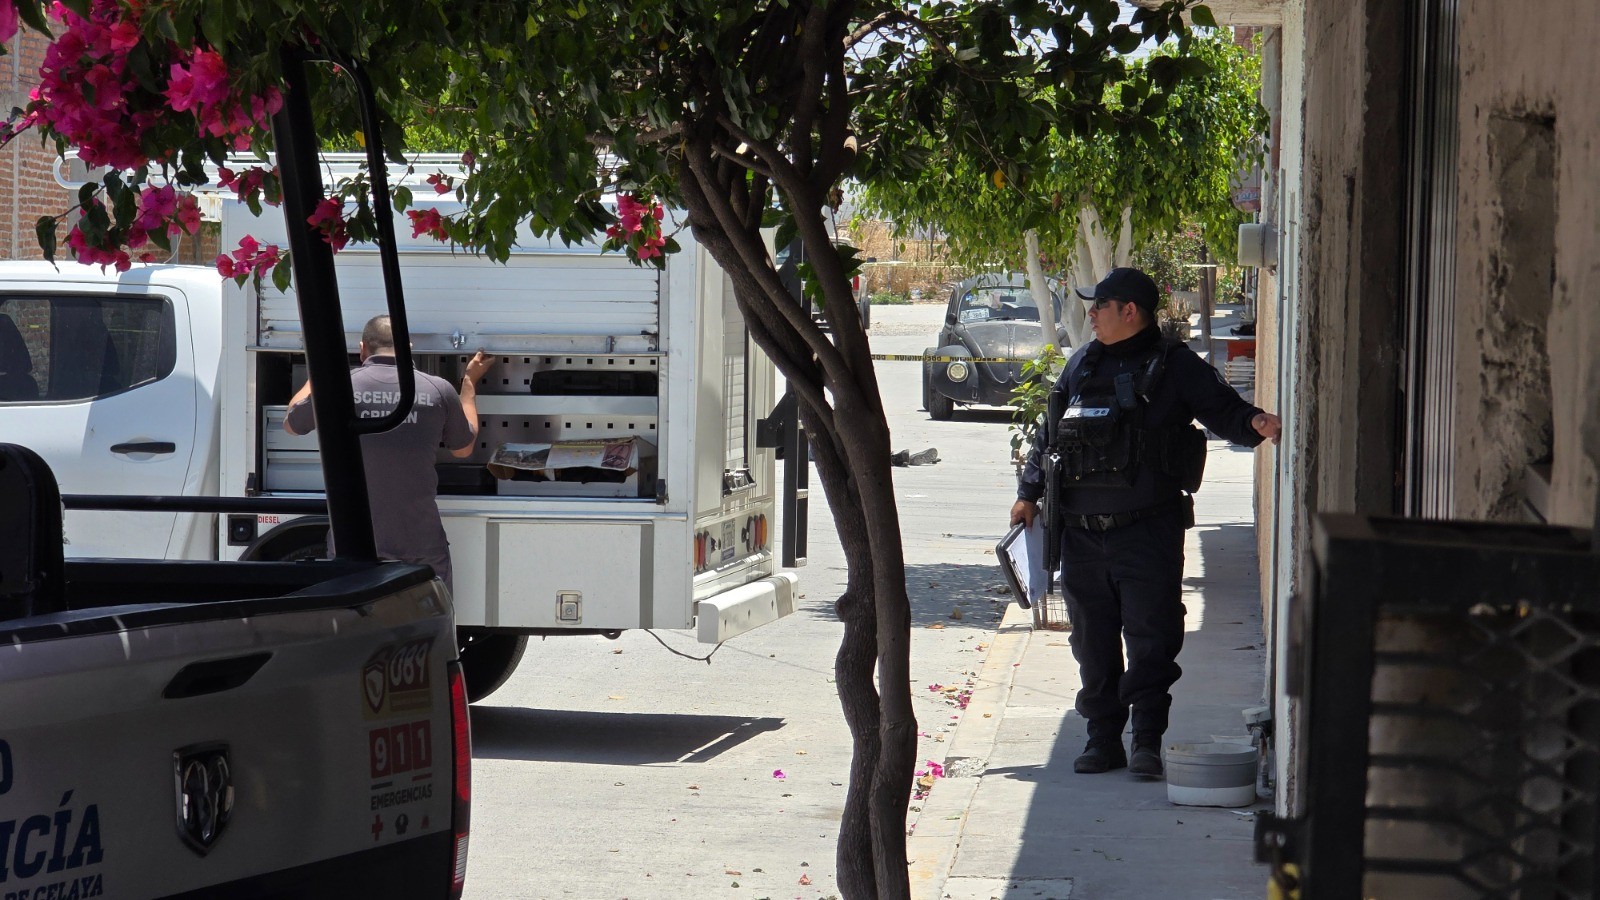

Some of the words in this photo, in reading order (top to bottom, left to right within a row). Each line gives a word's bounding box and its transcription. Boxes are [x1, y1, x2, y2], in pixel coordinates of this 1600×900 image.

[354, 391, 401, 404] SCENA
[258, 515, 280, 524] DIESEL
[390, 642, 428, 686] 089
[374, 727, 426, 771] 911
[371, 783, 433, 811] EMERGENCIAS
[32, 872, 104, 900] CELAYA
